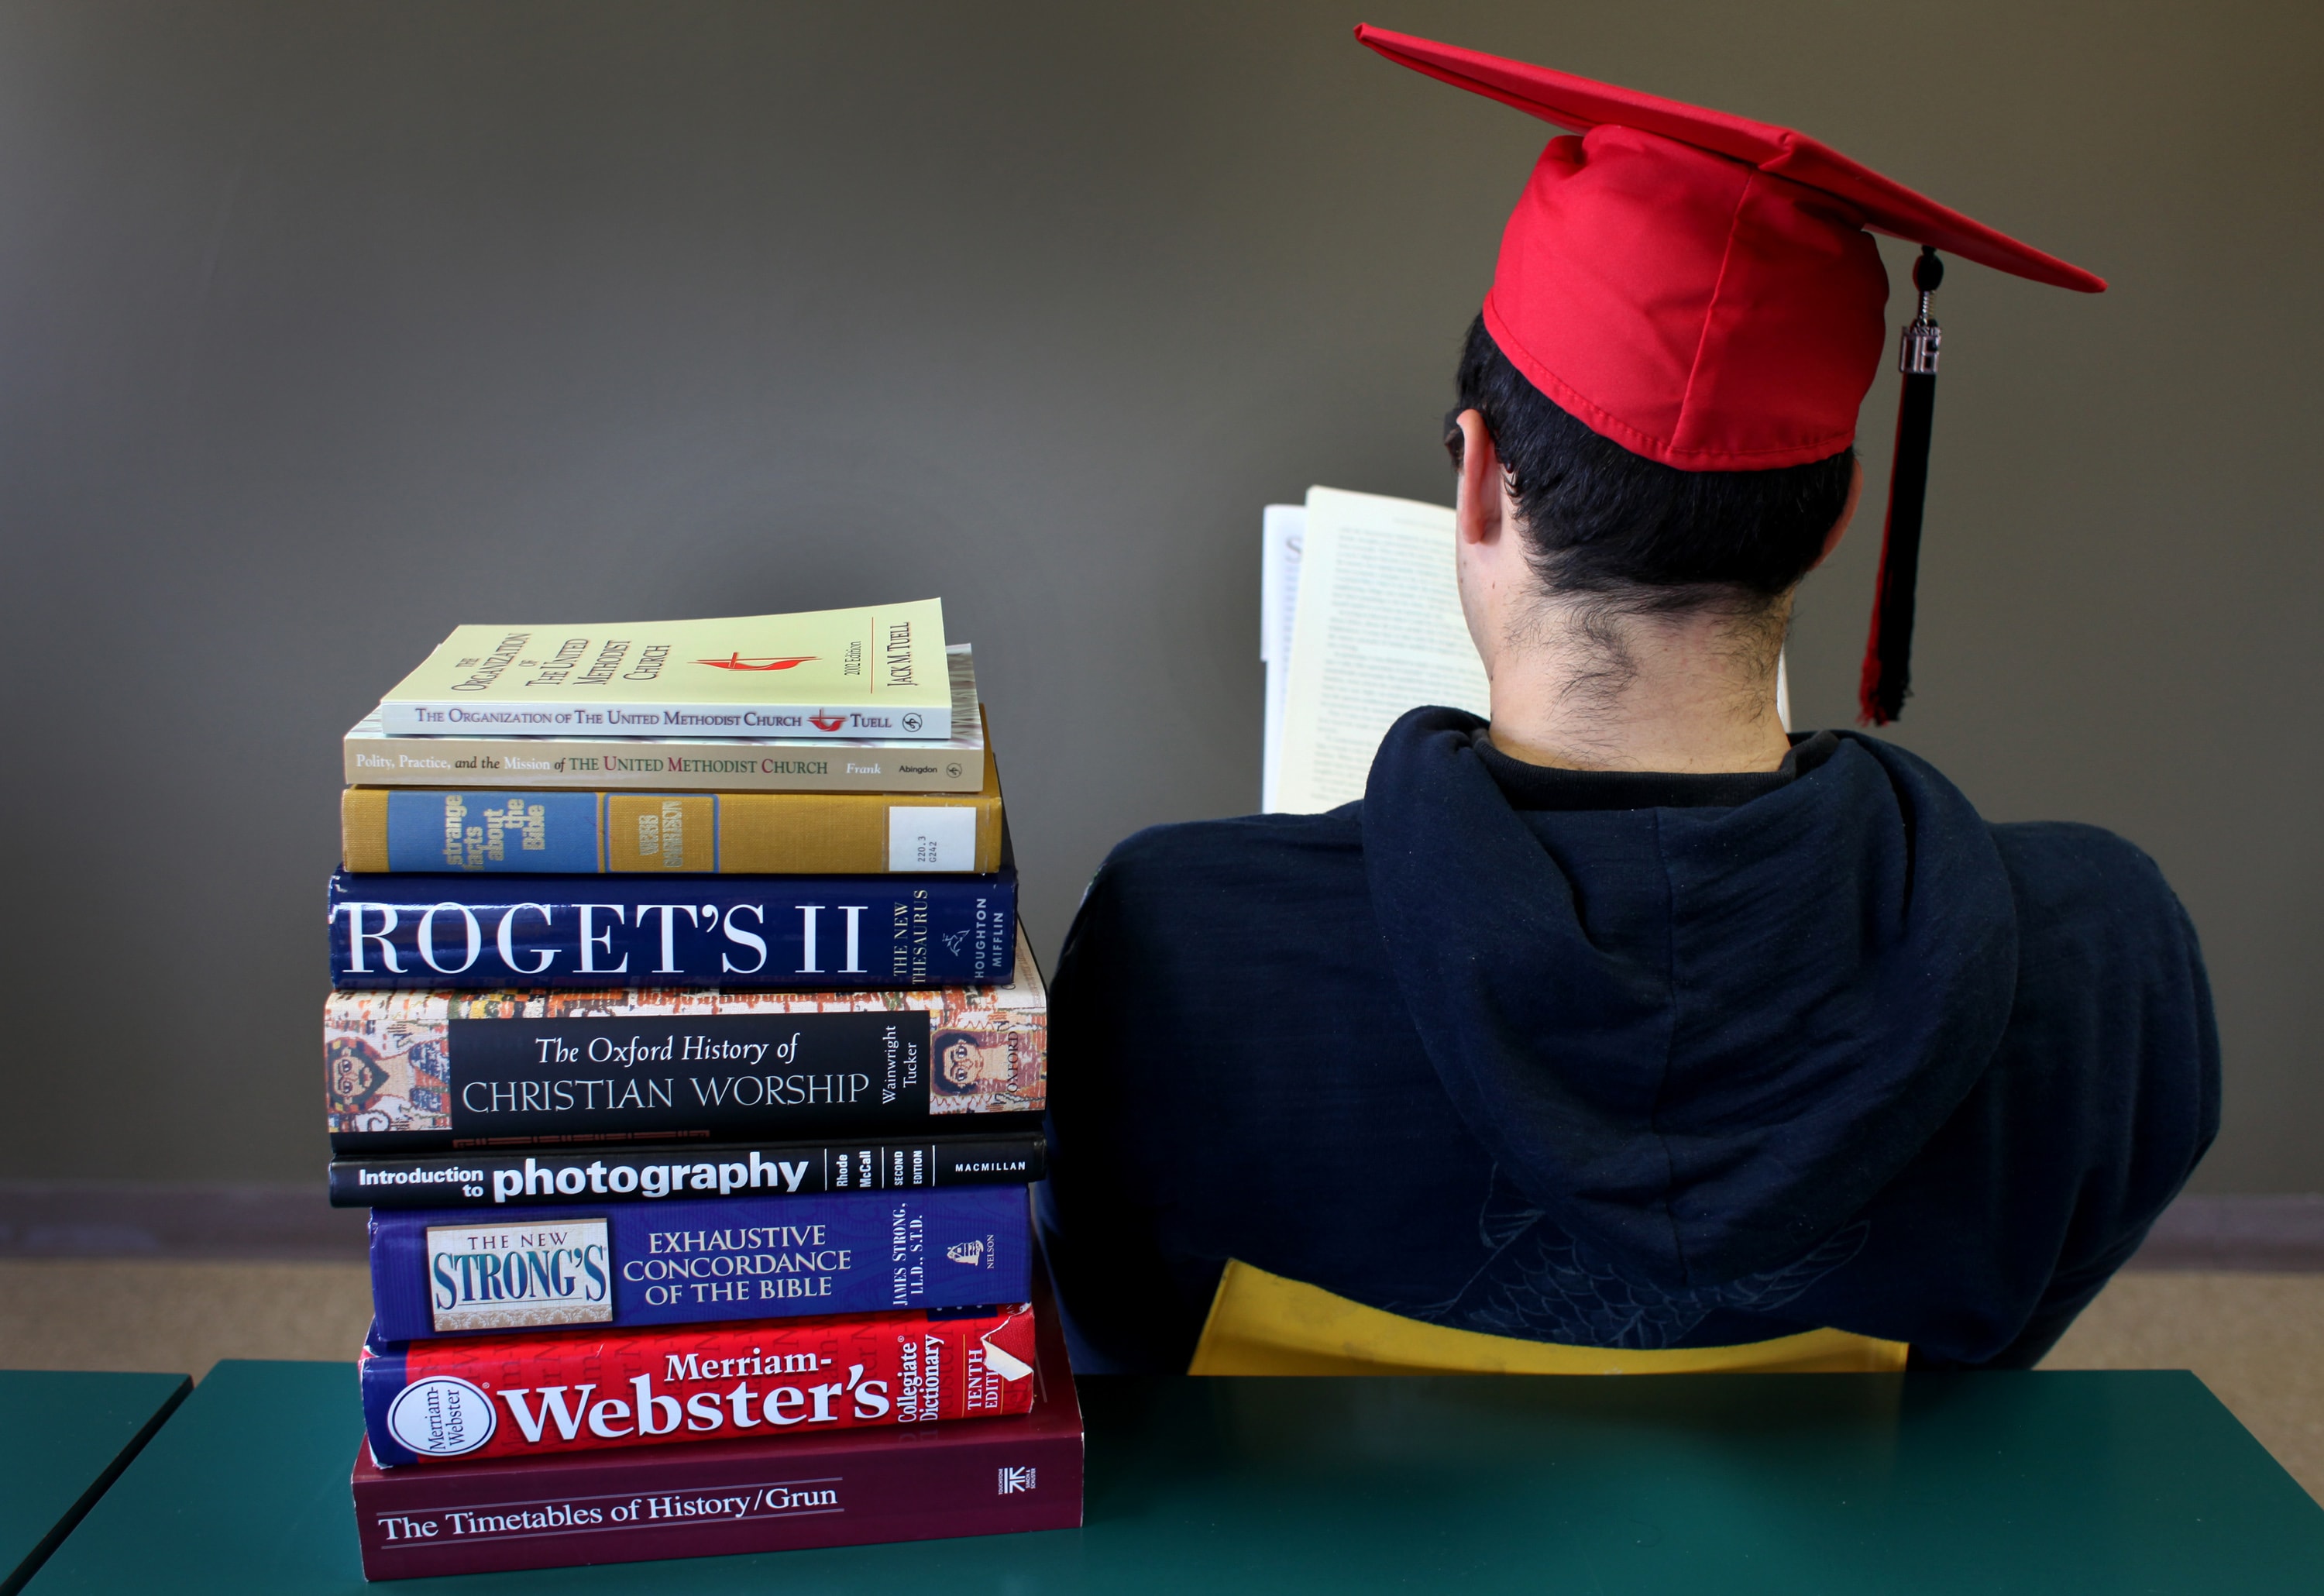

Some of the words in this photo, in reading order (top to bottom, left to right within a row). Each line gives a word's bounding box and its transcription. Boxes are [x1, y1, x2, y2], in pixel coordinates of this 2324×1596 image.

[844, 641, 861, 662] Edition
[887, 622, 910, 652] TUELL
[456, 657, 480, 668] THE
[844, 663, 861, 676] 2002
[887, 652, 910, 665] M.
[887, 665, 918, 686] JACK
[525, 671, 570, 686] THE
[356, 754, 396, 770] Polity,
[399, 755, 451, 771] Practice,
[455, 757, 477, 769] and
[481, 756, 500, 769] the
[504, 757, 550, 770] Mission
[555, 757, 566, 772] of
[569, 758, 600, 771] THE
[603, 756, 664, 772] UNITED
[668, 757, 758, 773] METHODIST
[761, 758, 828, 775] CHURCH
[847, 763, 882, 775] Frank
[899, 765, 938, 776] Abingdon
[442, 795, 467, 865] strange
[501, 799, 524, 829] the
[521, 805, 545, 850] Bible
[462, 827, 484, 871] facts
[476, 809, 504, 862] about
[918, 836, 927, 862] 220.3
[929, 841, 937, 863] G242
[340, 902, 768, 974] ROGET'S
[795, 905, 868, 974] II
[894, 902, 909, 939] NEW
[912, 889, 928, 985] THESAURUS
[975, 898, 987, 979] HOUGHTON
[992, 912, 1004, 967] MIFFLIN
[893, 945, 908, 977] THE
[535, 1037, 578, 1064] The
[588, 1035, 673, 1068] Oxford
[682, 1034, 769, 1065] History
[777, 1032, 801, 1065] of
[882, 1025, 900, 1105] Wainwright
[903, 1042, 917, 1088] Tucker
[1007, 1030, 1019, 1093] OXFORD
[462, 1078, 674, 1113] CHRISTIAN
[689, 1072, 869, 1106] WORSHIP
[359, 1166, 484, 1185] Introduction
[493, 1151, 809, 1203] photography
[837, 1154, 848, 1187] Rhode
[859, 1151, 871, 1188] McCall
[895, 1151, 903, 1185] SECOND
[913, 1150, 923, 1185] EDITION
[955, 1161, 1026, 1172] MACMILLAN
[462, 1185, 484, 1198] to
[467, 1235, 509, 1250] THE
[521, 1231, 569, 1247] NEW
[648, 1224, 826, 1254] EXHAUSTIVE
[892, 1202, 908, 1261] STRONG,
[909, 1215, 923, 1252] S.T.D.
[623, 1250, 851, 1281] CONCORDANCE
[910, 1257, 925, 1295] LL.D.,
[645, 1285, 682, 1305] OF
[691, 1281, 749, 1303] THE
[759, 1276, 832, 1300] BIBLE
[892, 1268, 908, 1305] JAMES
[664, 1347, 832, 1382] Merriam-
[920, 1333, 944, 1422] Dictionary
[968, 1349, 983, 1410] TENTH
[497, 1364, 890, 1443] Webster's
[985, 1370, 999, 1409] EDITI
[425, 1386, 446, 1450] Merriam-
[448, 1389, 464, 1446] Webster
[378, 1518, 438, 1540] The
[445, 1504, 602, 1536] Timetables
[610, 1498, 641, 1522] of
